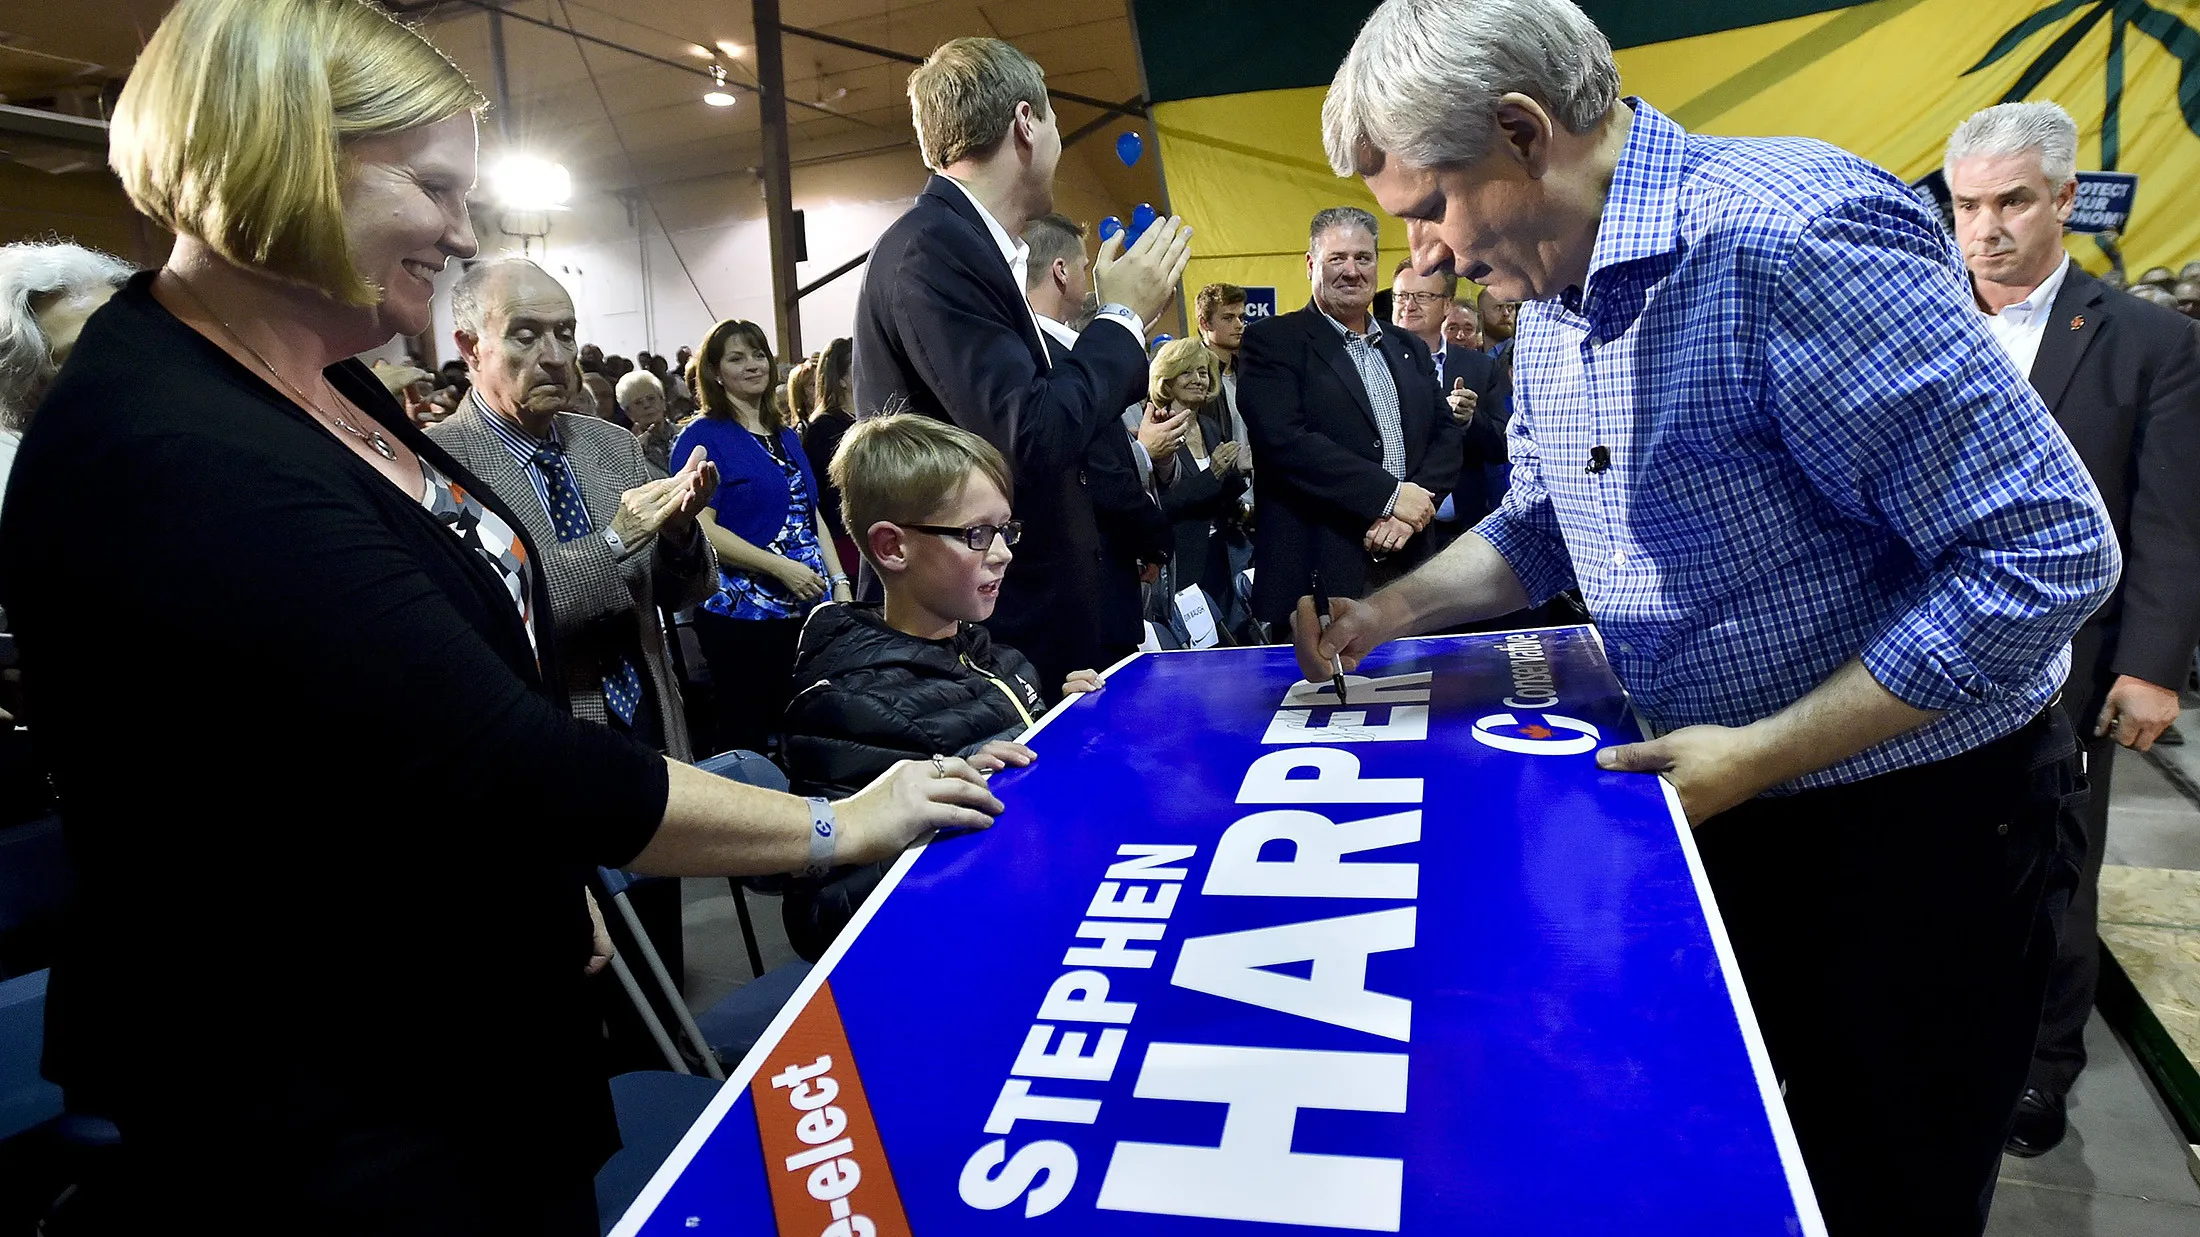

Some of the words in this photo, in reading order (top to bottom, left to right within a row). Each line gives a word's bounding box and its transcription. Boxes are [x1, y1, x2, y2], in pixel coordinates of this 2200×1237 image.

[2077, 182, 2130, 197] OTECT
[1245, 302, 1270, 317] CK
[1493, 633, 1560, 709] Conservative
[1096, 670, 1434, 1233] HARPER
[958, 843, 1198, 1219] STEPHEN
[770, 1054, 877, 1237] e-elect
